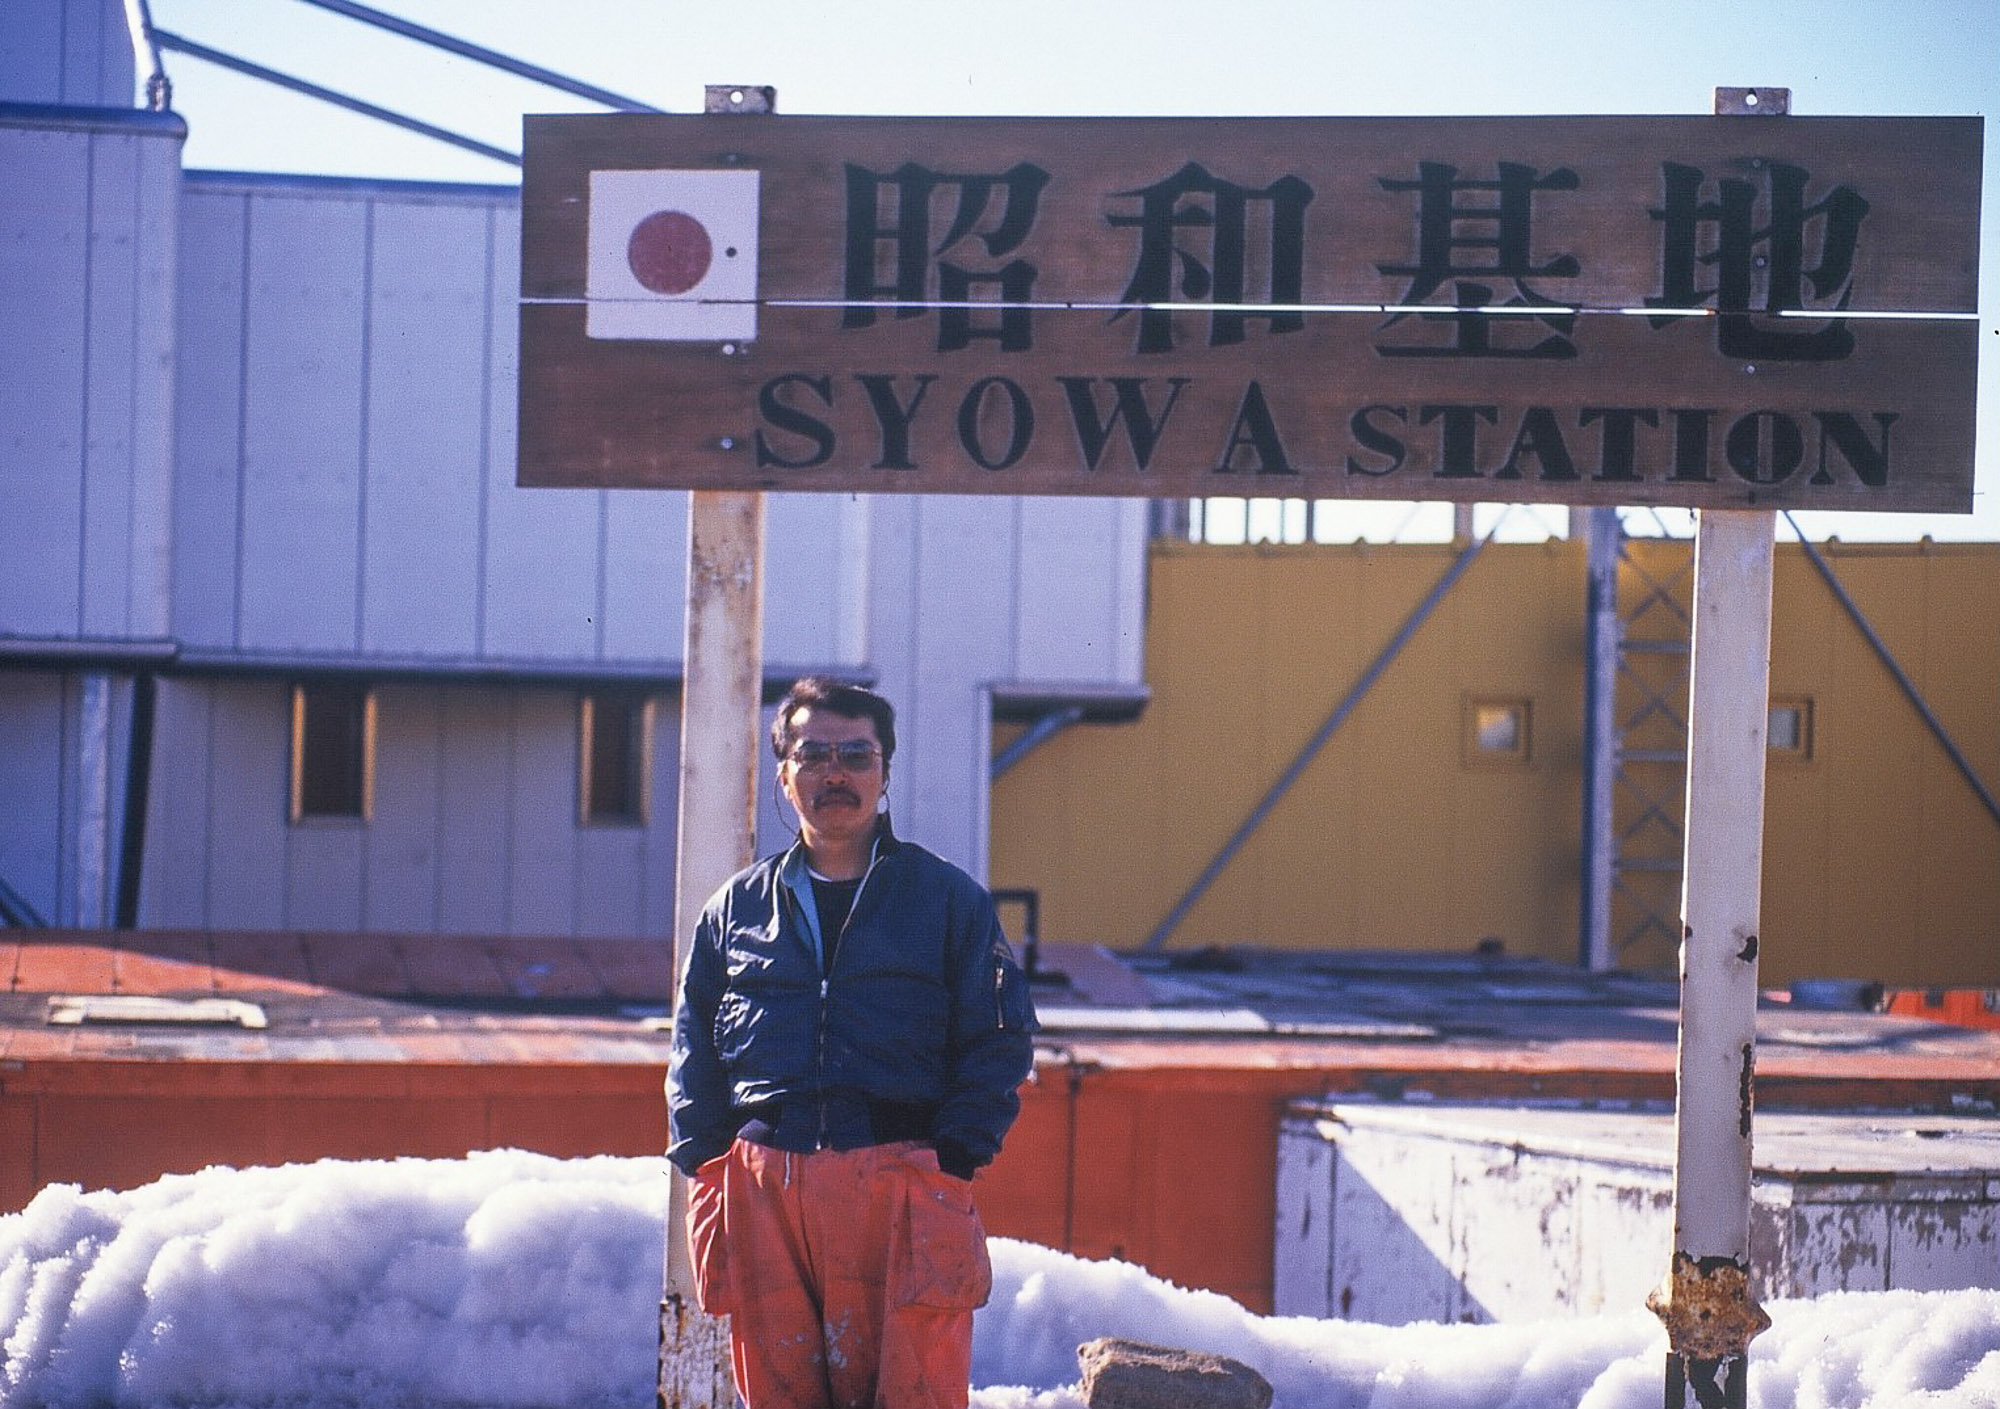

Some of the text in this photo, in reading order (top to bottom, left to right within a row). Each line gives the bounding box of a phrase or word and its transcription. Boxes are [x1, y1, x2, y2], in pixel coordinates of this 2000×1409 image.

[842, 161, 1870, 360] 昭和基地
[755, 373, 1899, 485] SYOWA STATION
